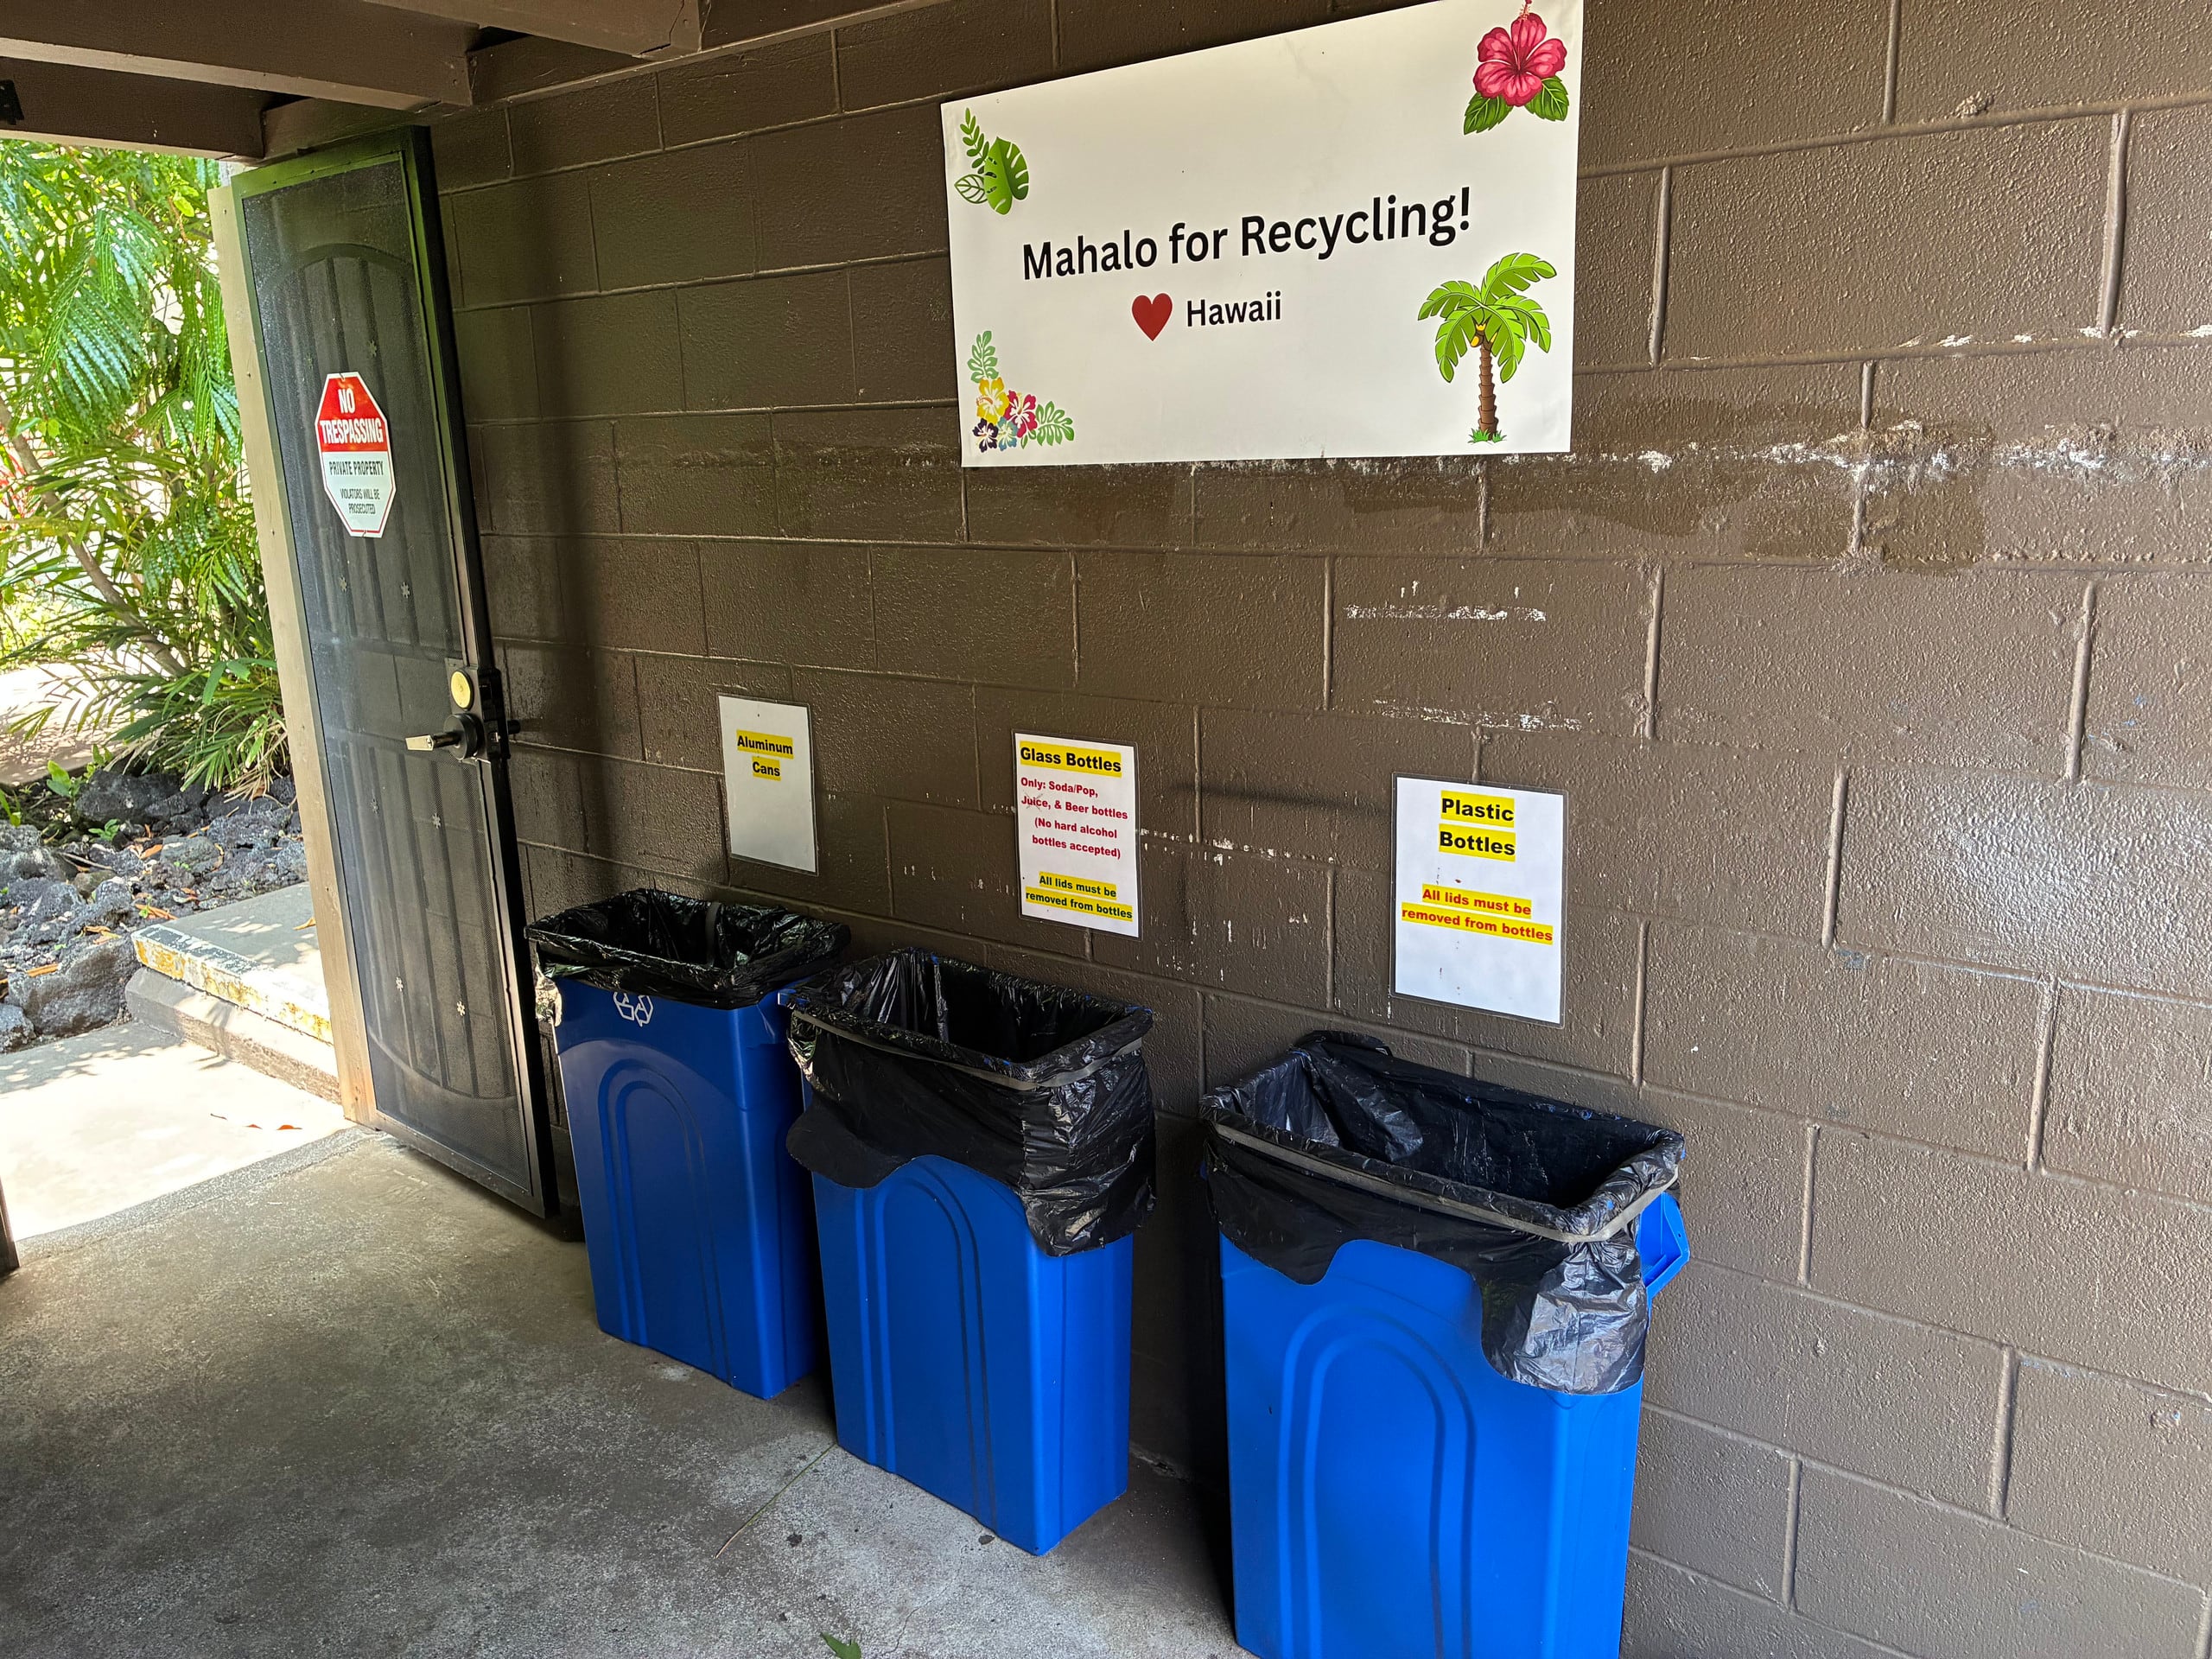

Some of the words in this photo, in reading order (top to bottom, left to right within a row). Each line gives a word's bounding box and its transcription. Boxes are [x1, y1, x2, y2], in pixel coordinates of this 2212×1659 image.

[1023, 229, 1157, 281] Mahalo
[1168, 222, 1228, 264] for
[1241, 186, 1471, 260] Recycling!
[1186, 290, 1281, 327] Hawaii
[338, 388, 356, 414] NO
[320, 418, 384, 444] TRESPASSING
[329, 461, 353, 475] PRIVATE
[353, 461, 384, 475] PROPERTY
[340, 489, 362, 499] VIOLATORS
[363, 489, 373, 499] WILL
[374, 489, 380, 499] BE
[348, 503, 376, 514] PROSECUTED
[737, 735, 793, 755] Aluminum
[753, 761, 780, 777] Cans
[1020, 747, 1061, 765] Glass
[1066, 753, 1122, 772] Bottles
[1020, 777, 1046, 791] Only:
[1049, 781, 1098, 798] Soda/Pop,
[1020, 795, 1051, 810] Juice,
[1054, 800, 1062, 809] &
[1065, 802, 1089, 813] Beer
[1092, 804, 1128, 819] bottles
[1441, 798, 1514, 821] Plastic
[1035, 817, 1052, 828] (No
[1054, 820, 1077, 832] hard
[1080, 823, 1117, 838] alcohol
[1032, 835, 1067, 849] bottles
[1070, 843, 1121, 860] accepted)
[1440, 831, 1516, 855] Bottles
[1039, 875, 1052, 886] All
[1055, 879, 1073, 889] lids
[1104, 887, 1116, 897] be
[1026, 892, 1067, 906] removed
[1071, 899, 1093, 911] from
[1096, 904, 1133, 918] bottles
[1422, 888, 1440, 901] All
[1445, 892, 1469, 905] lids
[1474, 899, 1509, 912] must
[1514, 903, 1531, 915] be
[1402, 909, 1460, 925] removed
[1465, 918, 1497, 931] from
[1502, 923, 1553, 941] bottles
